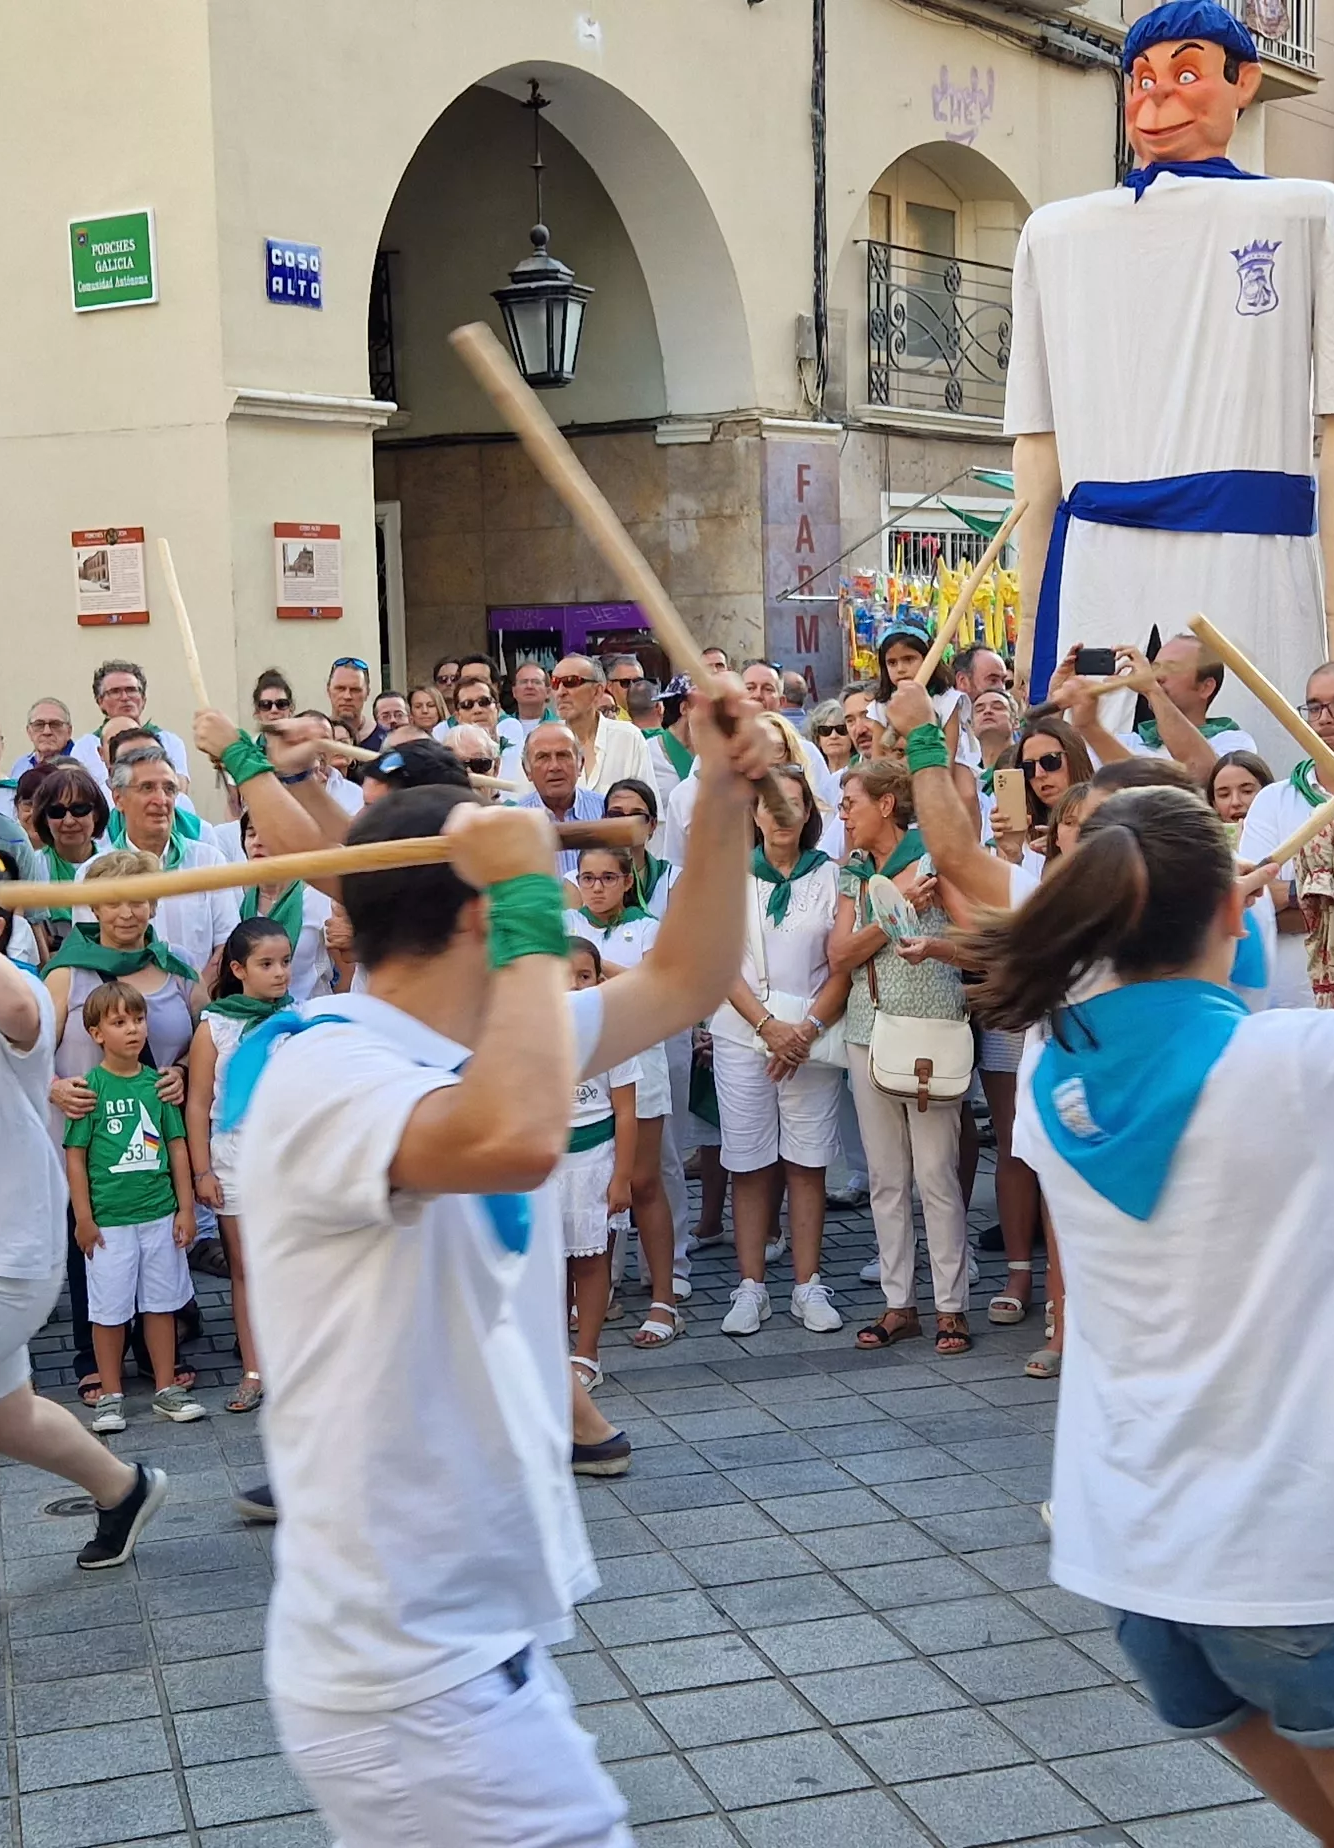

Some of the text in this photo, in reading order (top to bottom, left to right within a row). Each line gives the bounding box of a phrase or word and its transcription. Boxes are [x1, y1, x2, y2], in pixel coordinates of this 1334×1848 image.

[91, 239, 136, 256] PORCHES
[95, 256, 134, 272] GALICIA
[272, 249, 318, 272] COSO
[77, 277, 113, 292] Comunidad
[272, 277, 319, 298] ALTO
[106, 1098, 135, 1114] RGT
[125, 1144, 143, 1161] 53
